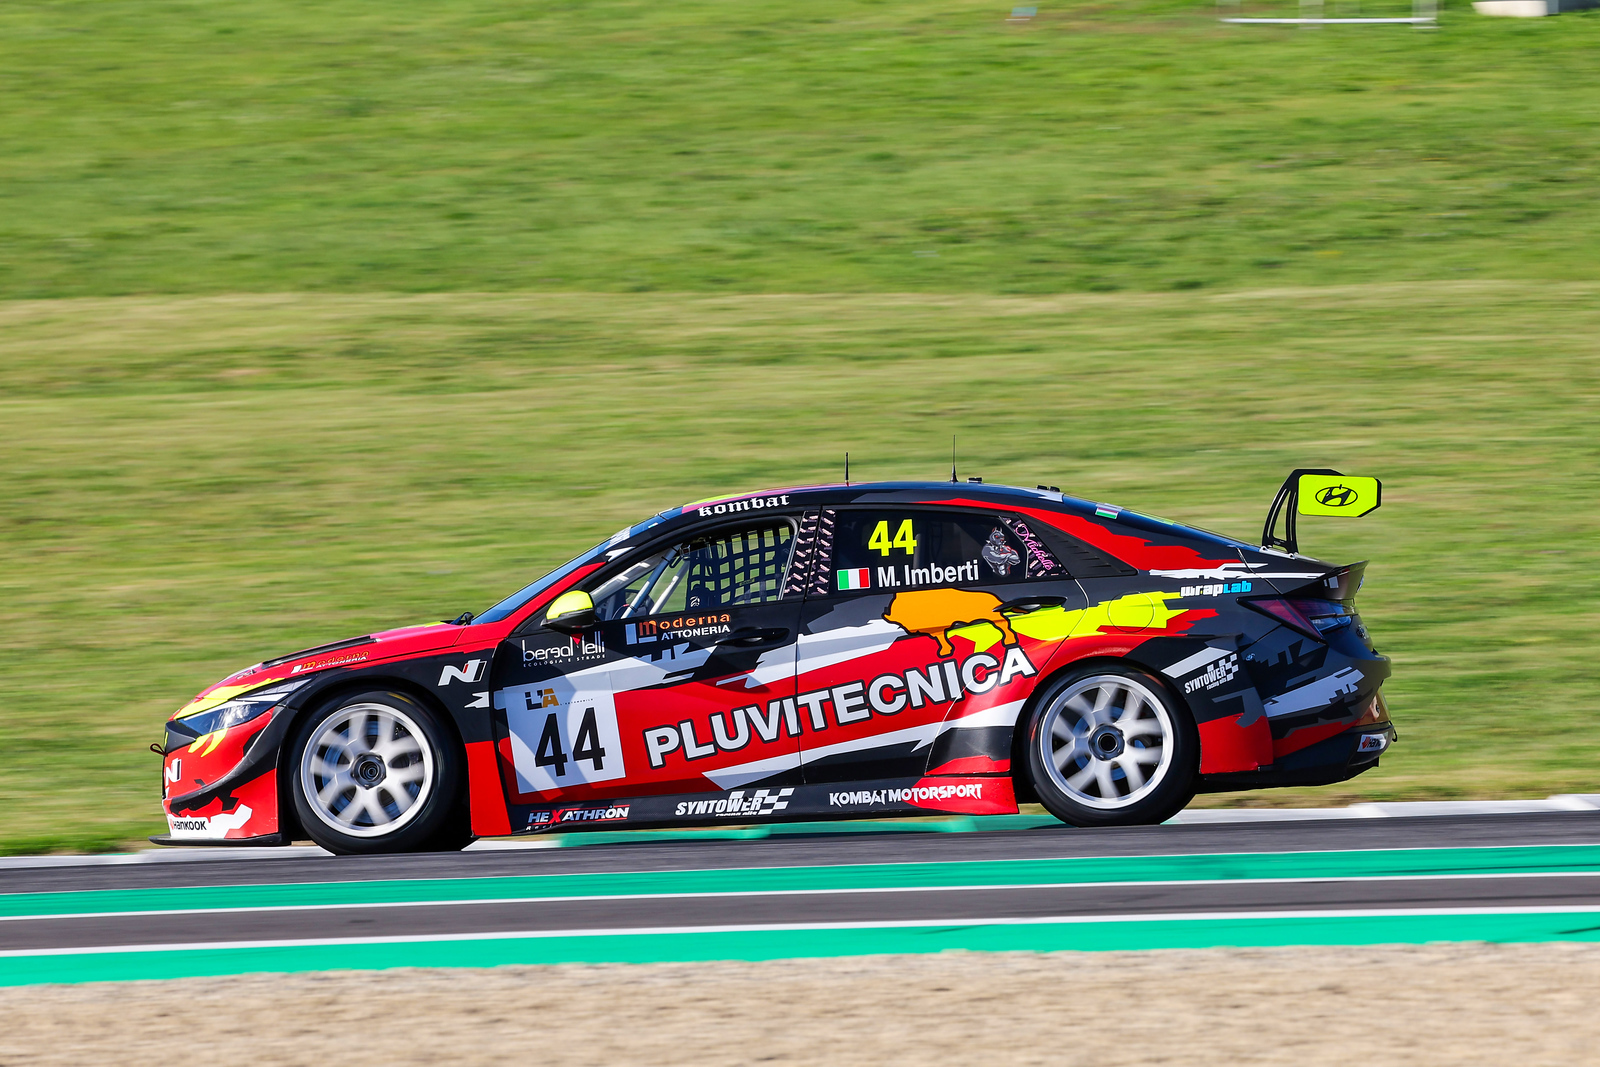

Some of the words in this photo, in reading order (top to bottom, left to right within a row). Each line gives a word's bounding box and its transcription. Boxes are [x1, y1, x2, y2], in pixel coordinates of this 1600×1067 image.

[868, 519, 918, 557] 44
[877, 566, 901, 588] M.
[904, 559, 979, 586] Imberti
[1184, 665, 1227, 694] SYNTOWER
[643, 645, 1037, 769] PLUVITECNICA
[535, 707, 606, 777] 44
[675, 796, 763, 816] SYNTOWER
[829, 789, 887, 808] KOMBAT
[888, 783, 983, 803] MOTORSPORT
[527, 806, 630, 825] HEXATHRON
